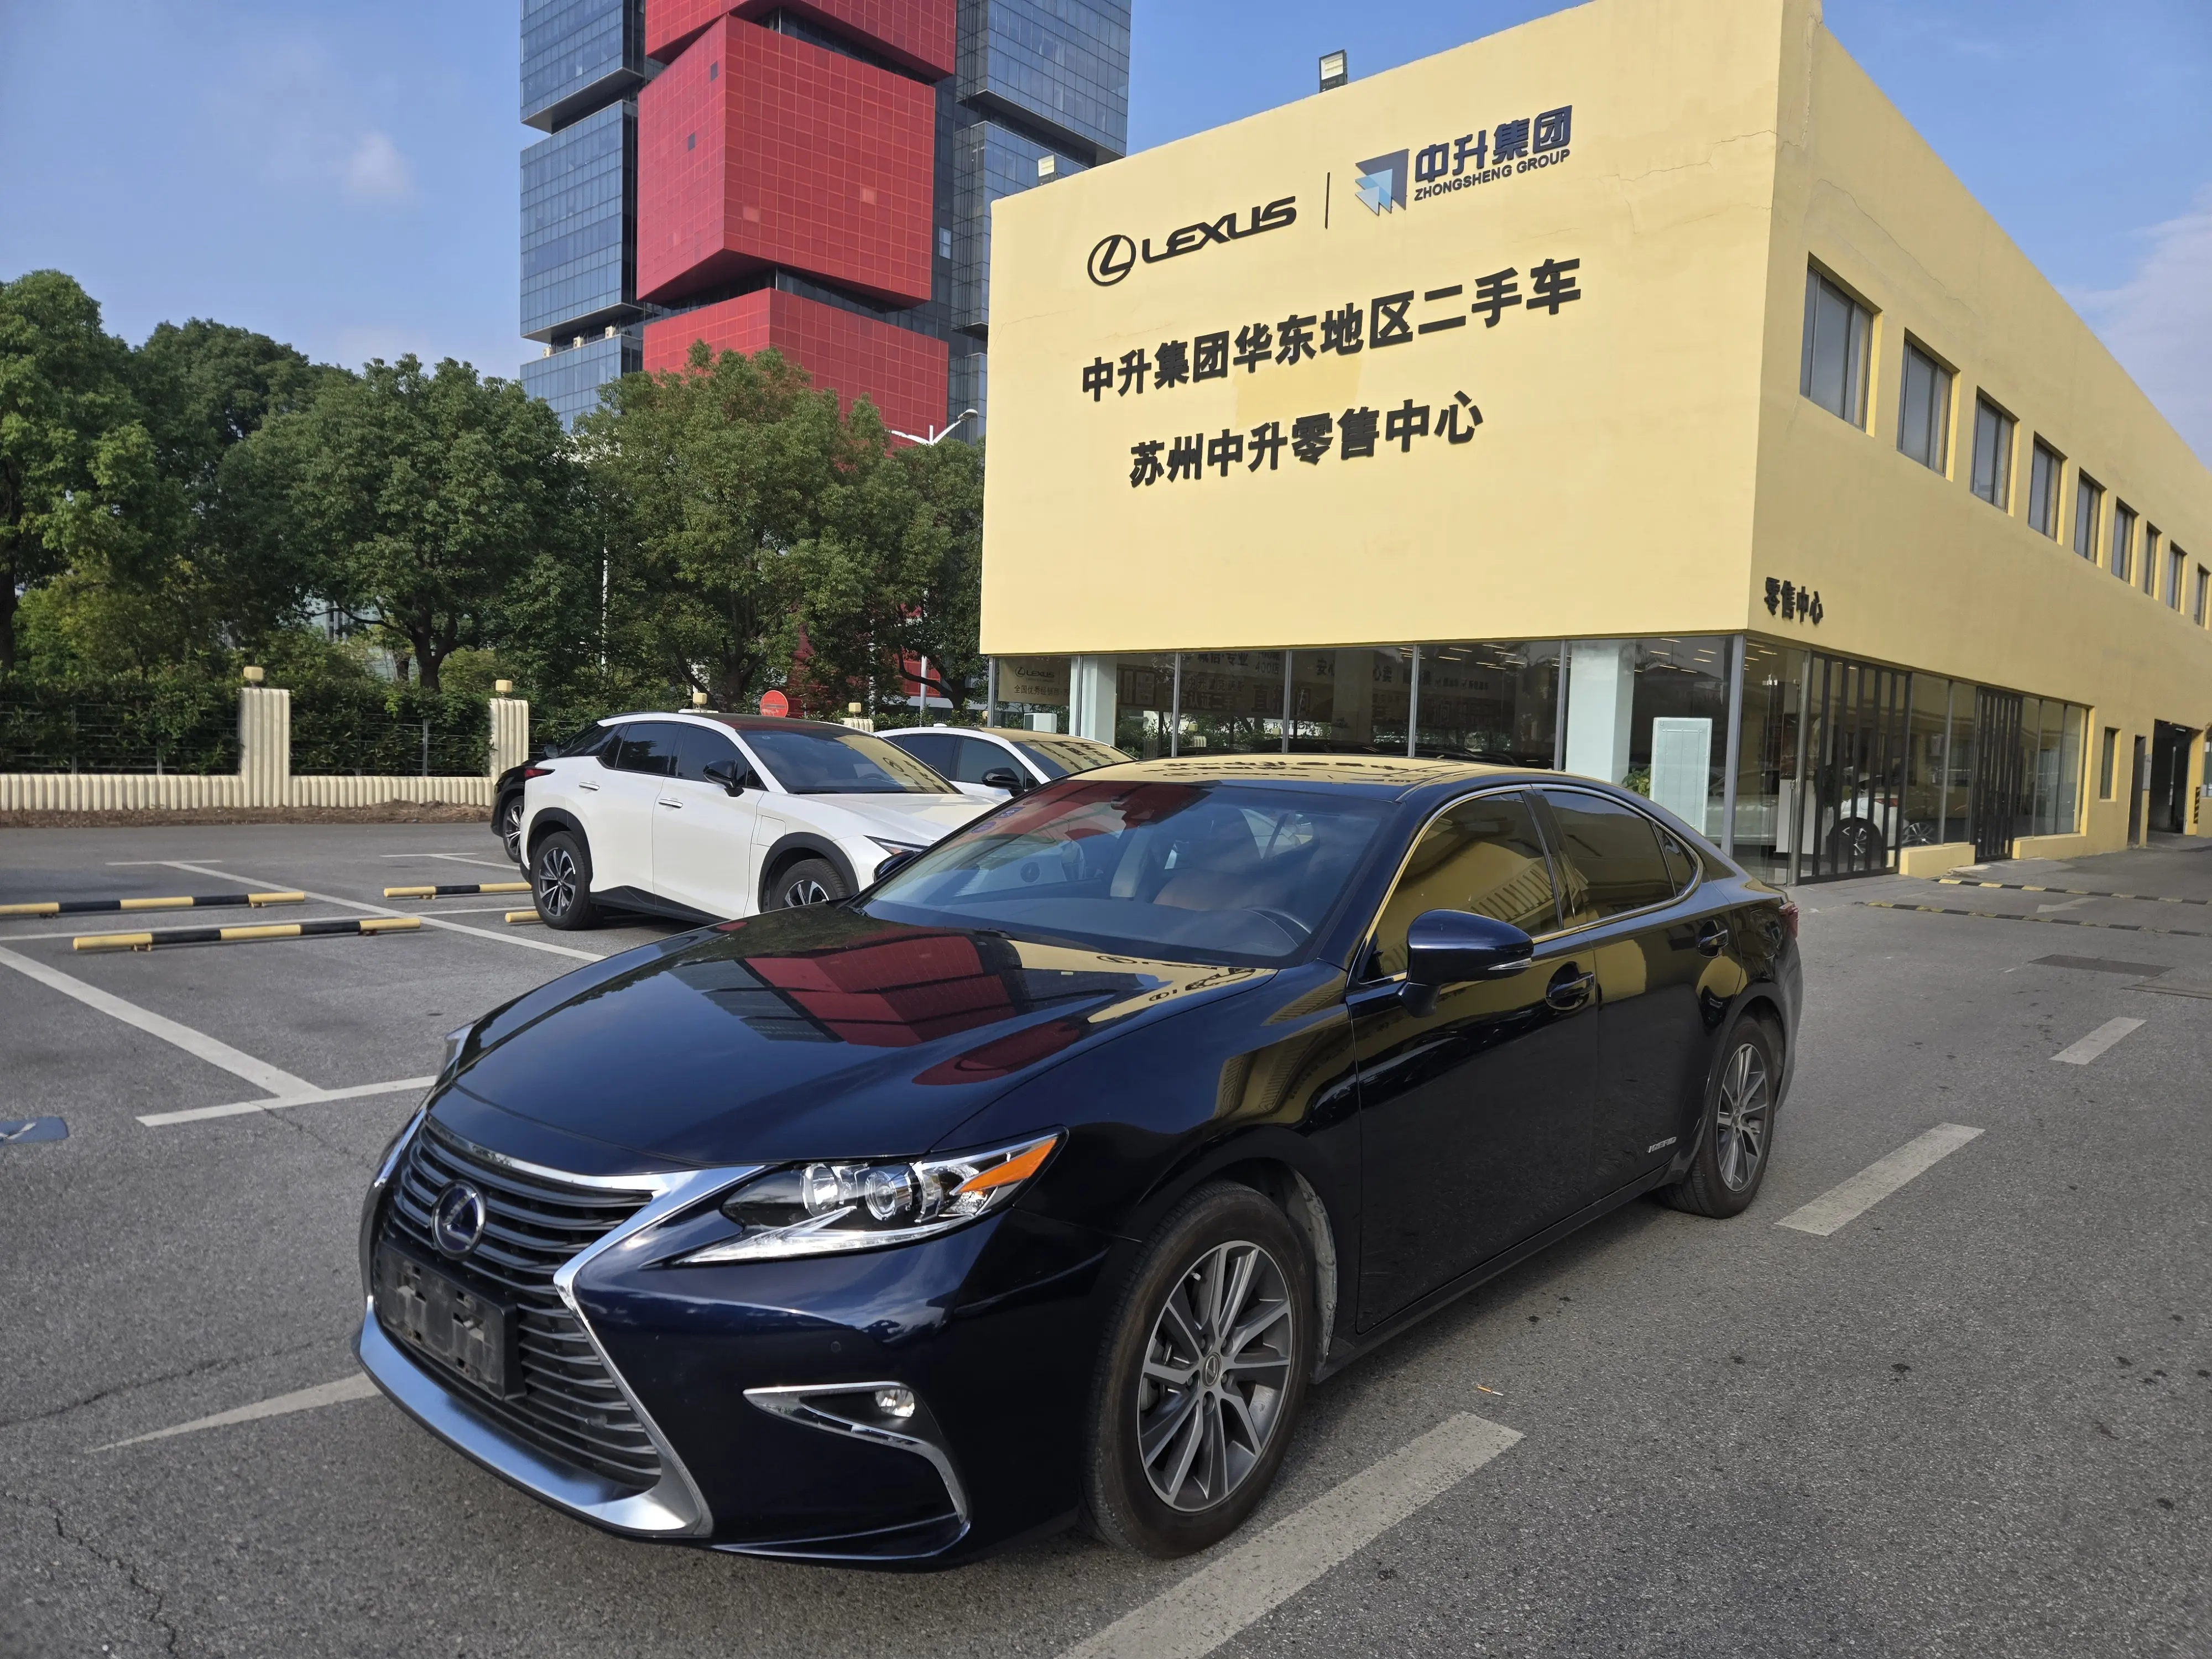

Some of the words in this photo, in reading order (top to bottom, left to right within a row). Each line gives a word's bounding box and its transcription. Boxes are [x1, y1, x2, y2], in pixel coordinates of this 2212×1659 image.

[1414, 105, 1572, 183] 中升集团
[1414, 165, 1512, 201] ZHONGSHENG
[1516, 149, 1571, 174] GROUP
[1141, 196, 1297, 264] LEXUS
[1082, 258, 1581, 402] 中升集团华东地区二手车
[1129, 390, 1483, 488] 苏州中升零售中心
[1764, 577, 1823, 624] 零售中心
[1026, 670, 1055, 678] LEXUS
